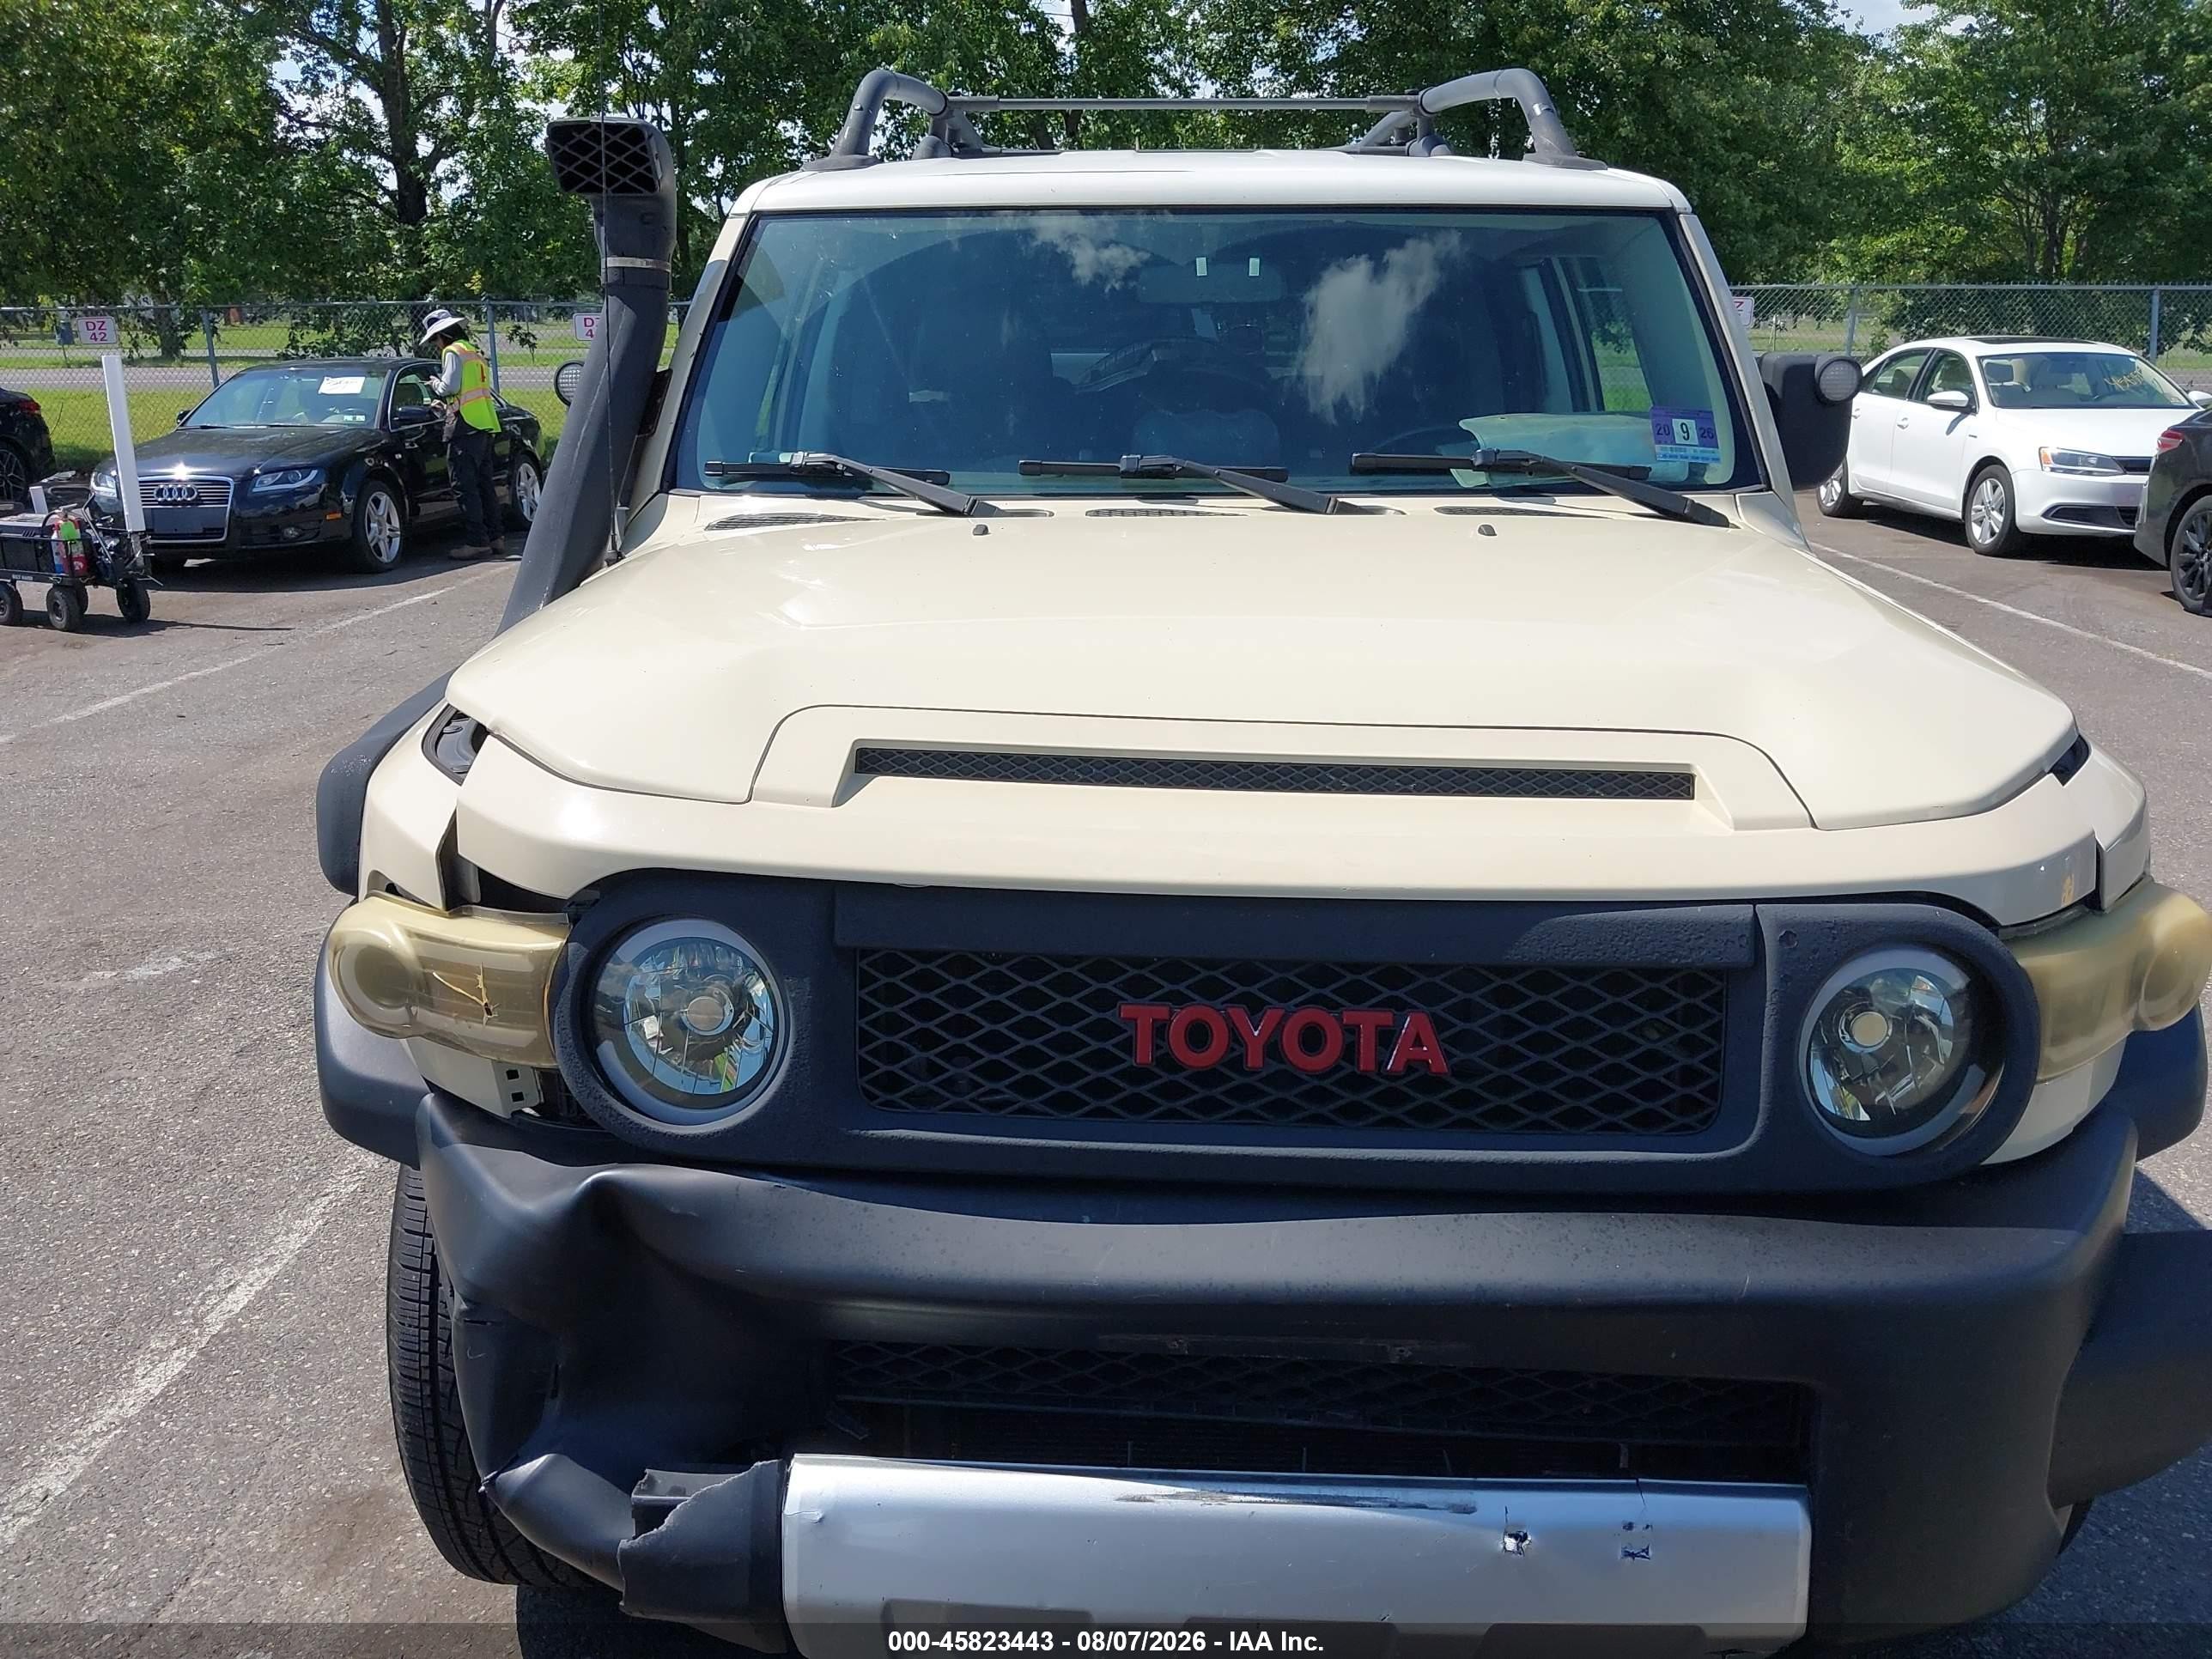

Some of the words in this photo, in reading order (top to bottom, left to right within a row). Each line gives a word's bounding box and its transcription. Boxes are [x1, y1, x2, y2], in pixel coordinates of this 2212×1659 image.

[85, 320, 107, 331] DZ
[89, 331, 108, 342] 42
[585, 329, 594, 338] 4
[1655, 422, 1671, 436] 20
[1680, 422, 1690, 441] 9
[1698, 427, 1715, 440] 26
[1118, 1001, 1451, 1077] TOYOTA
